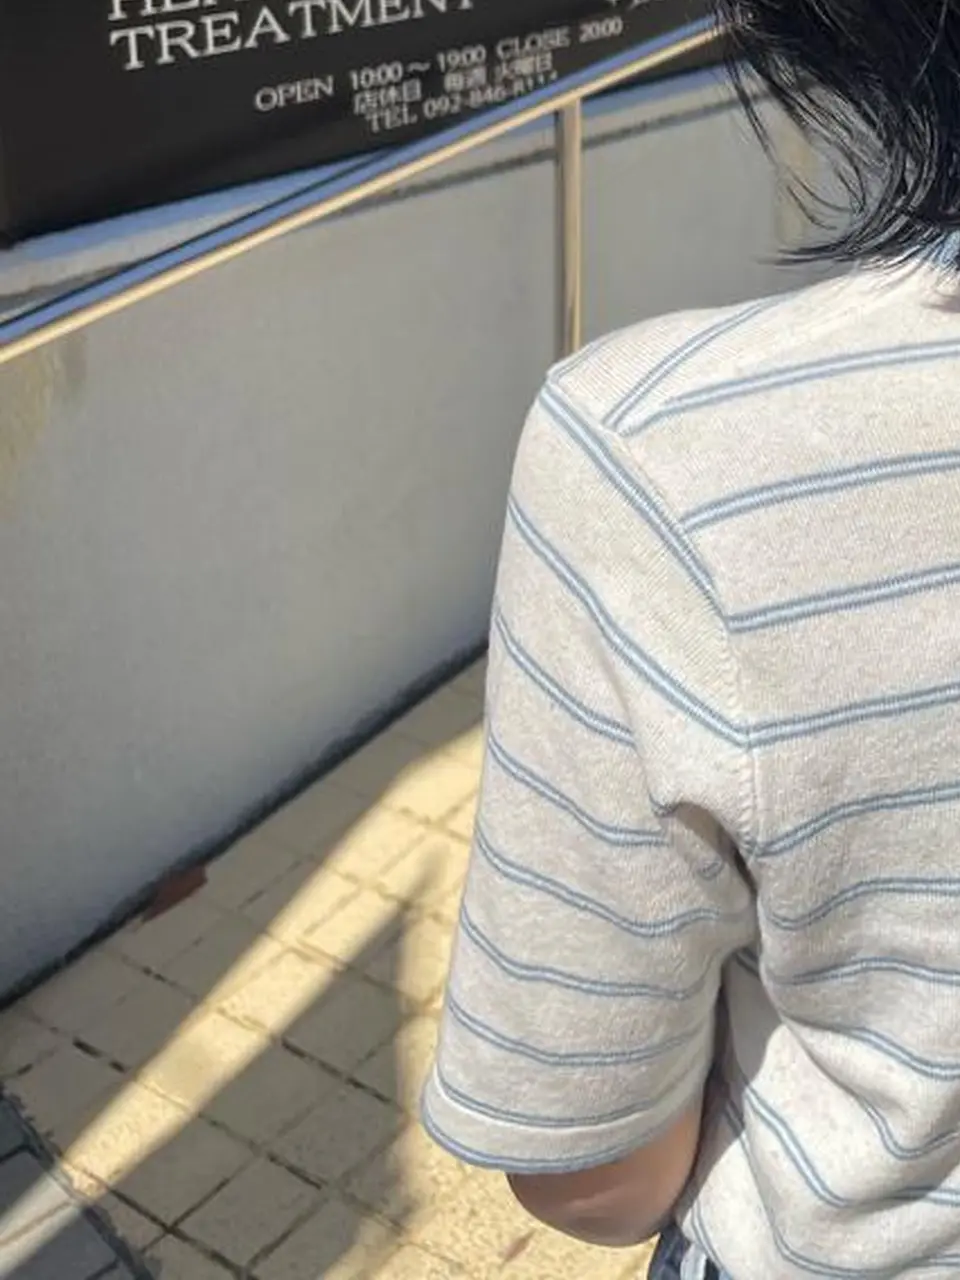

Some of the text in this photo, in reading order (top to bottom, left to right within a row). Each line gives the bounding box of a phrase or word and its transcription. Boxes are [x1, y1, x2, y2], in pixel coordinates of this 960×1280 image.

[254, 75, 335, 112] OPEN
[496, 26, 570, 60] CLOSE
[365, 104, 419, 133] TEL
